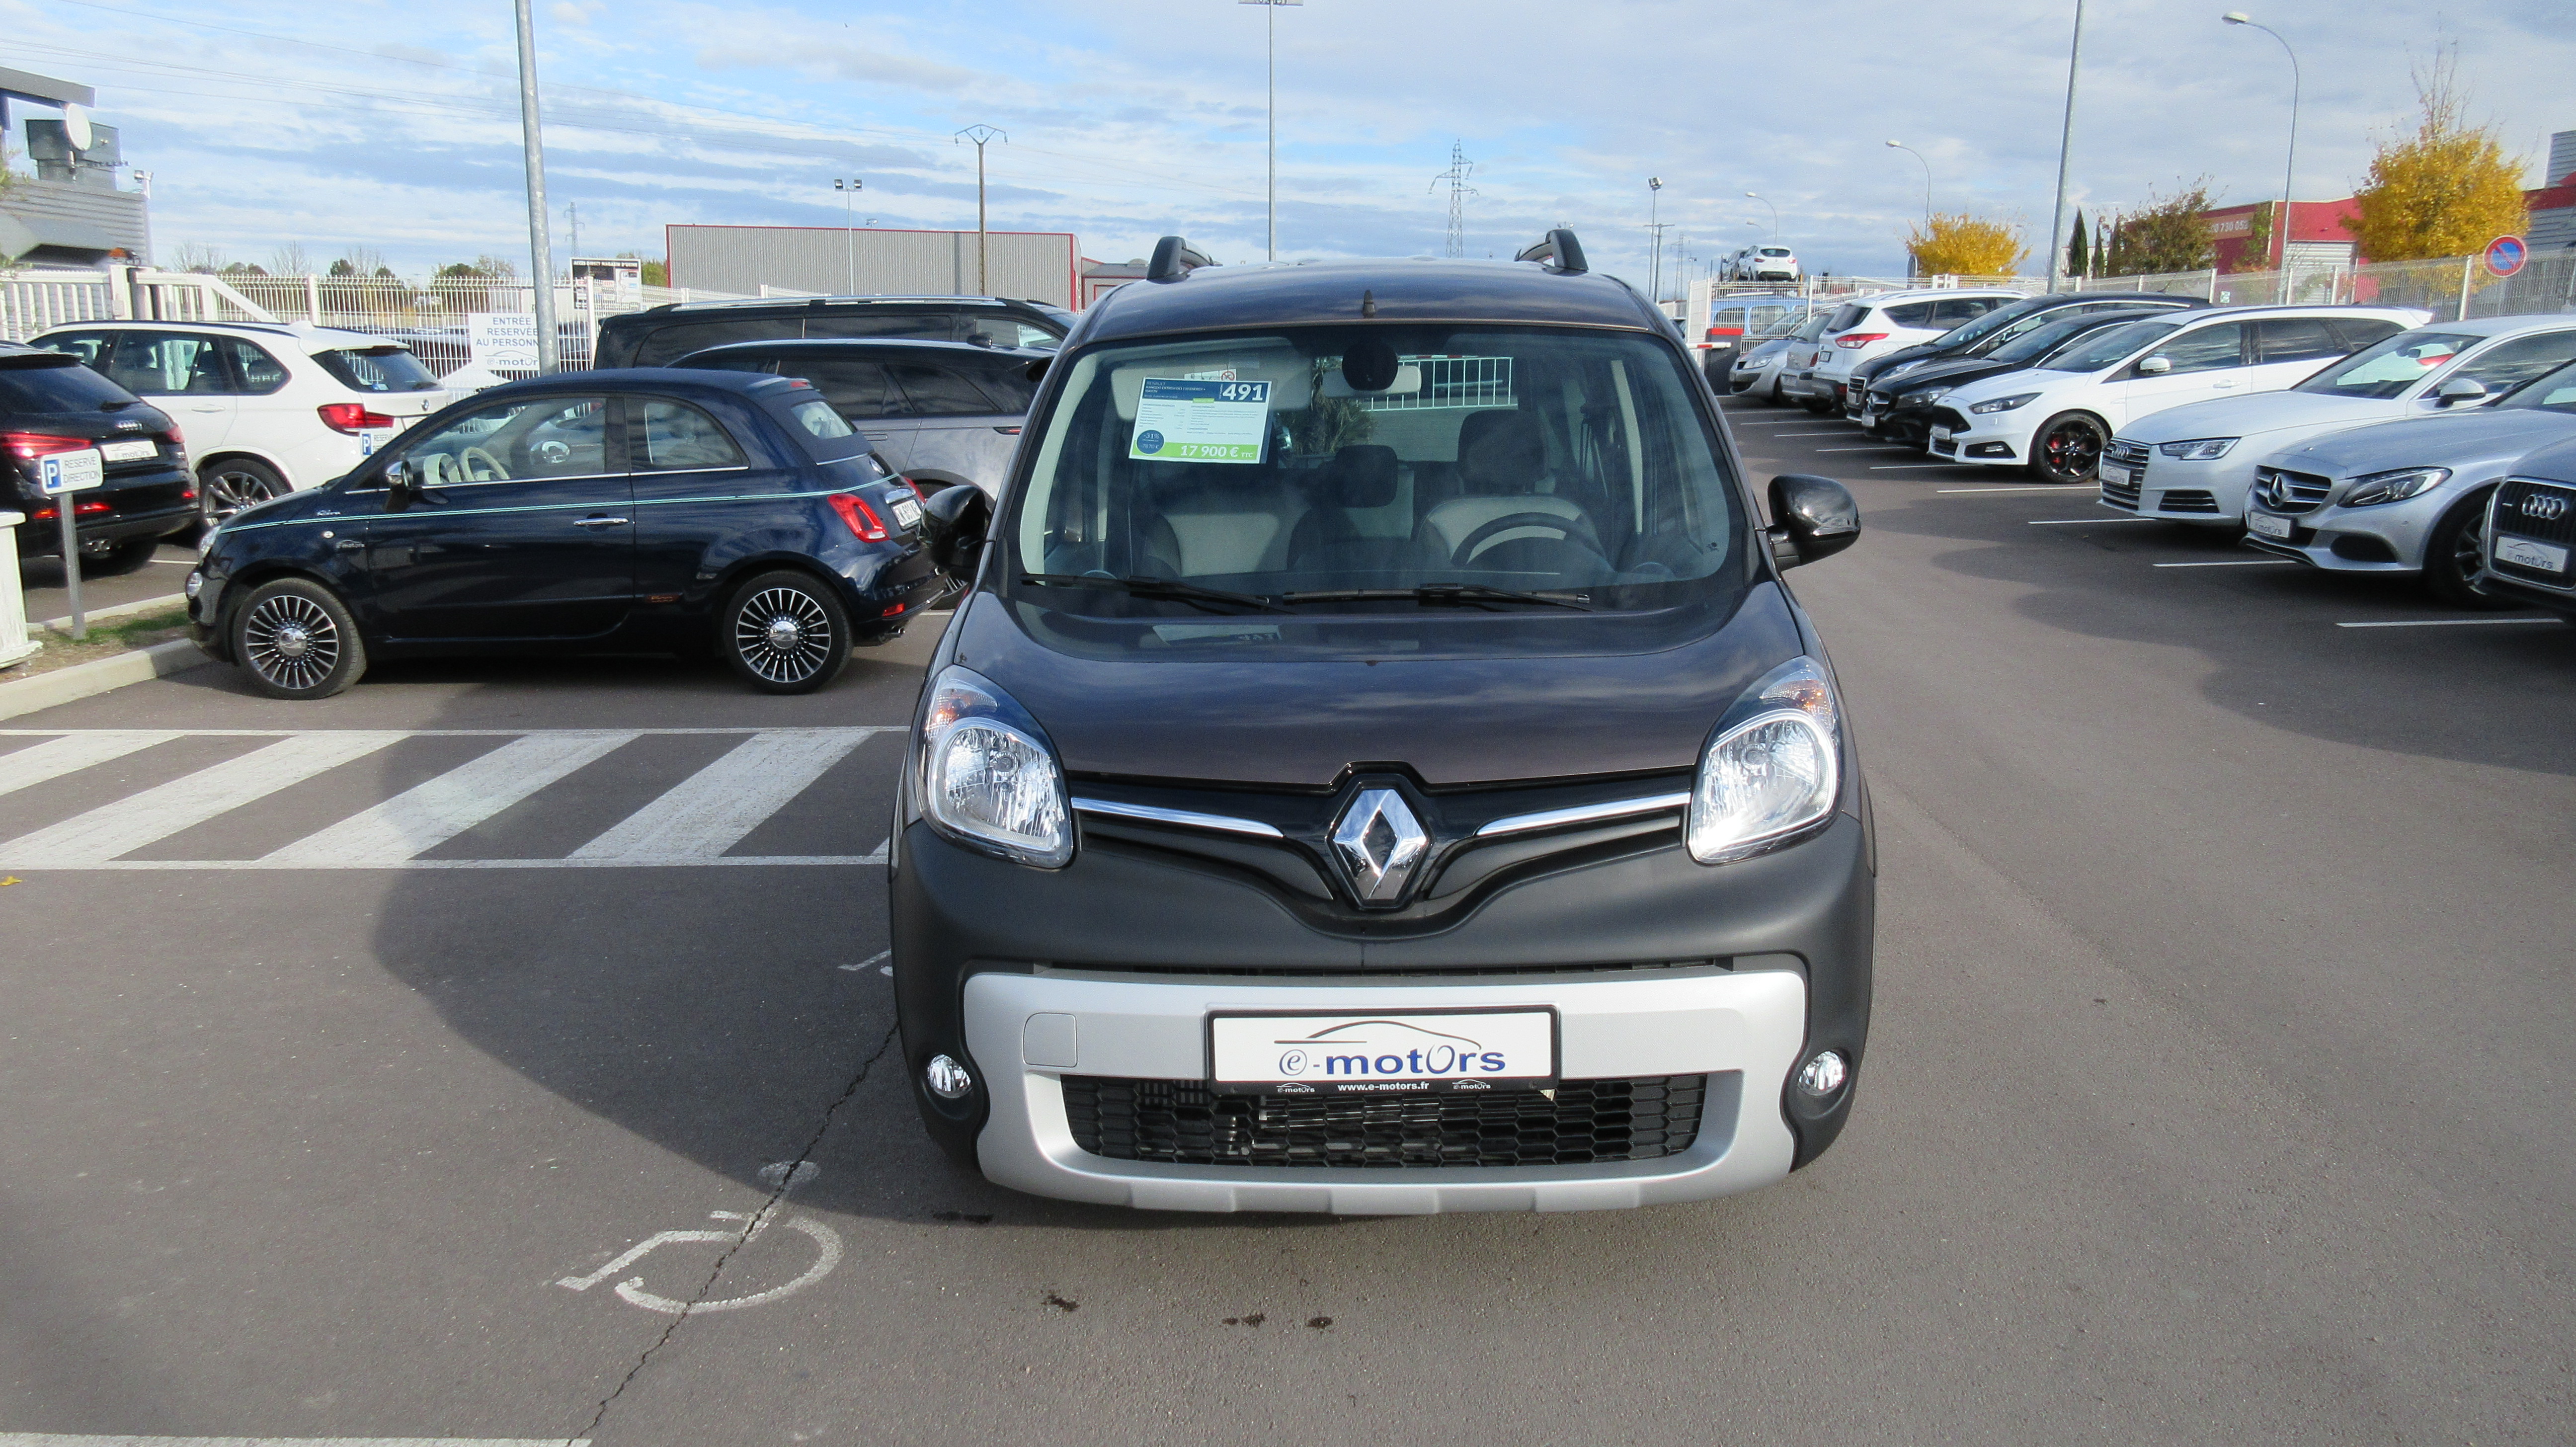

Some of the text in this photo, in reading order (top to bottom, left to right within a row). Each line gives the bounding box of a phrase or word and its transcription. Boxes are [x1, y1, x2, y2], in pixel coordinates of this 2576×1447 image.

[493, 316, 532, 325] ENTRÉE
[487, 326, 538, 335] RESERVÉE
[487, 357, 538, 366] e-motor
[1222, 384, 1263, 401] 491
[363, 436, 370, 453] P
[1181, 445, 1198, 457] 17
[1202, 446, 1227, 457] 900
[1230, 447, 1239, 457] €
[46, 463, 57, 484] P
[63, 471, 100, 483] DIRECTION
[1337, 1081, 1430, 1091] www.e-motors.fr
